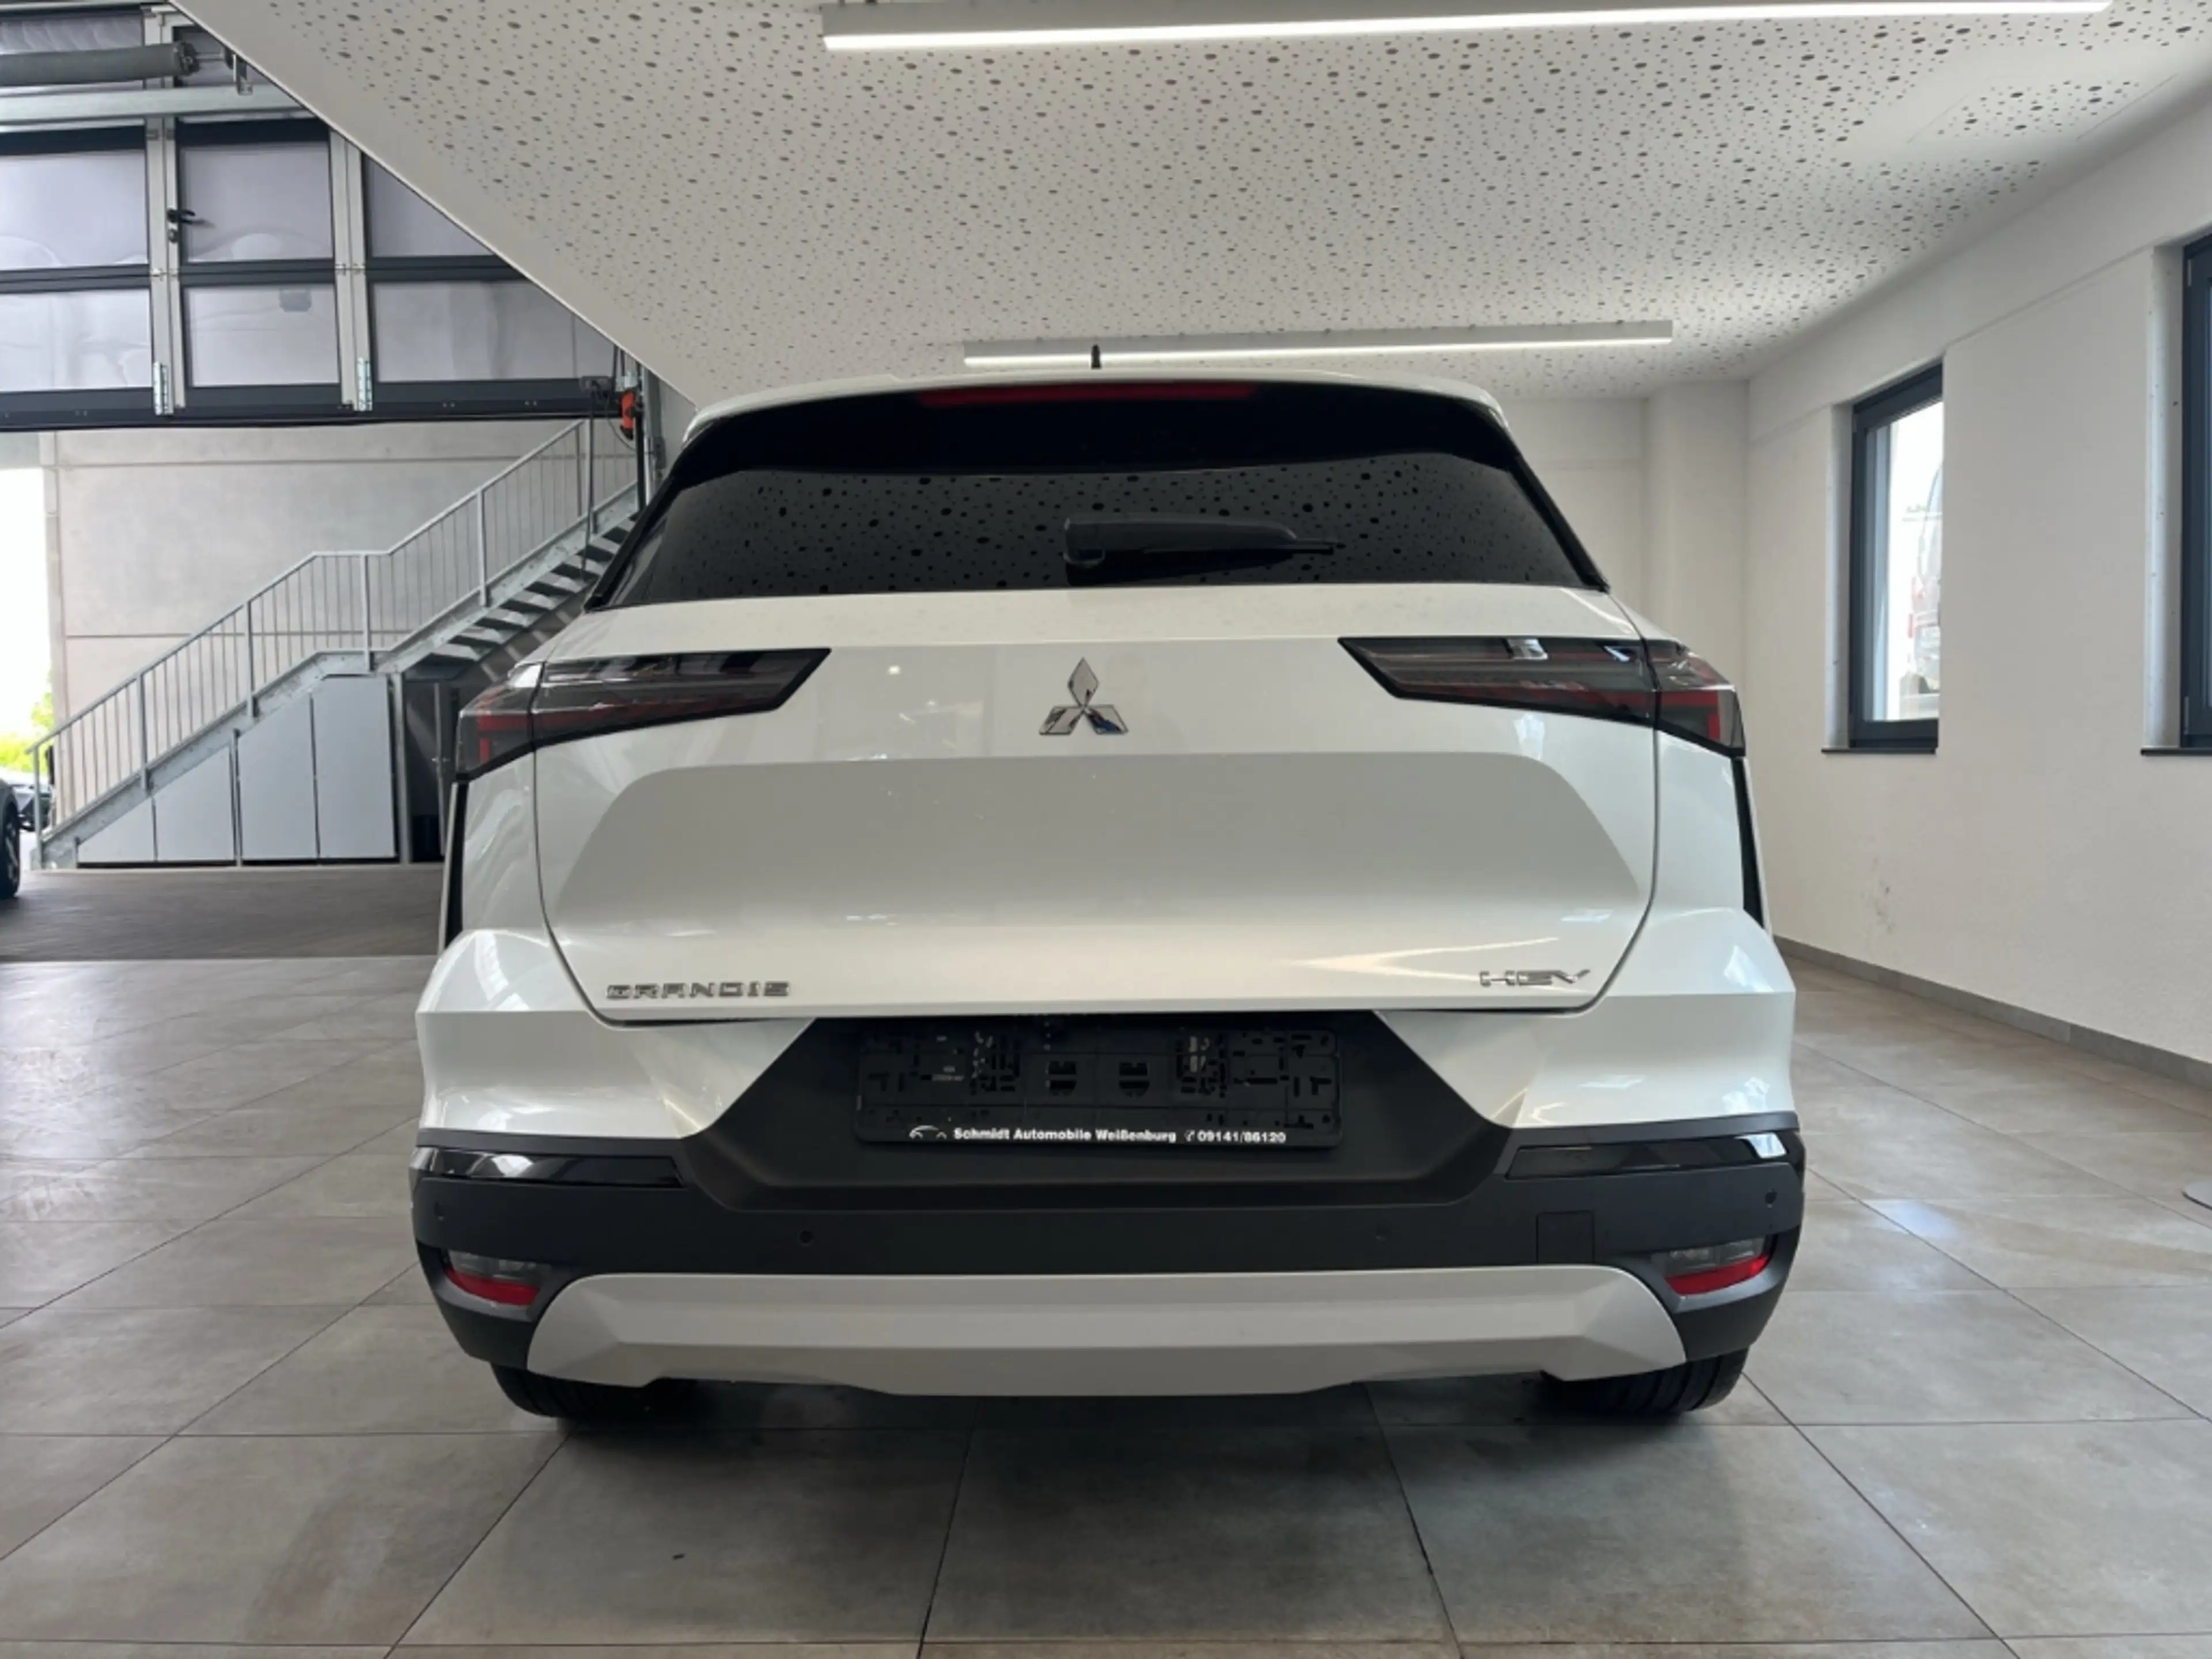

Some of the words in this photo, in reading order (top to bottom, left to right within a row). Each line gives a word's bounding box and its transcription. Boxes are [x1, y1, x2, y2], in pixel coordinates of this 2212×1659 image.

[1480, 969, 1590, 987] HEV
[607, 982, 790, 999] GRANDIS
[953, 1127, 1010, 1139] Schmidt
[1013, 1128, 1092, 1141] Automobile
[1096, 1129, 1176, 1143] Weißenburg
